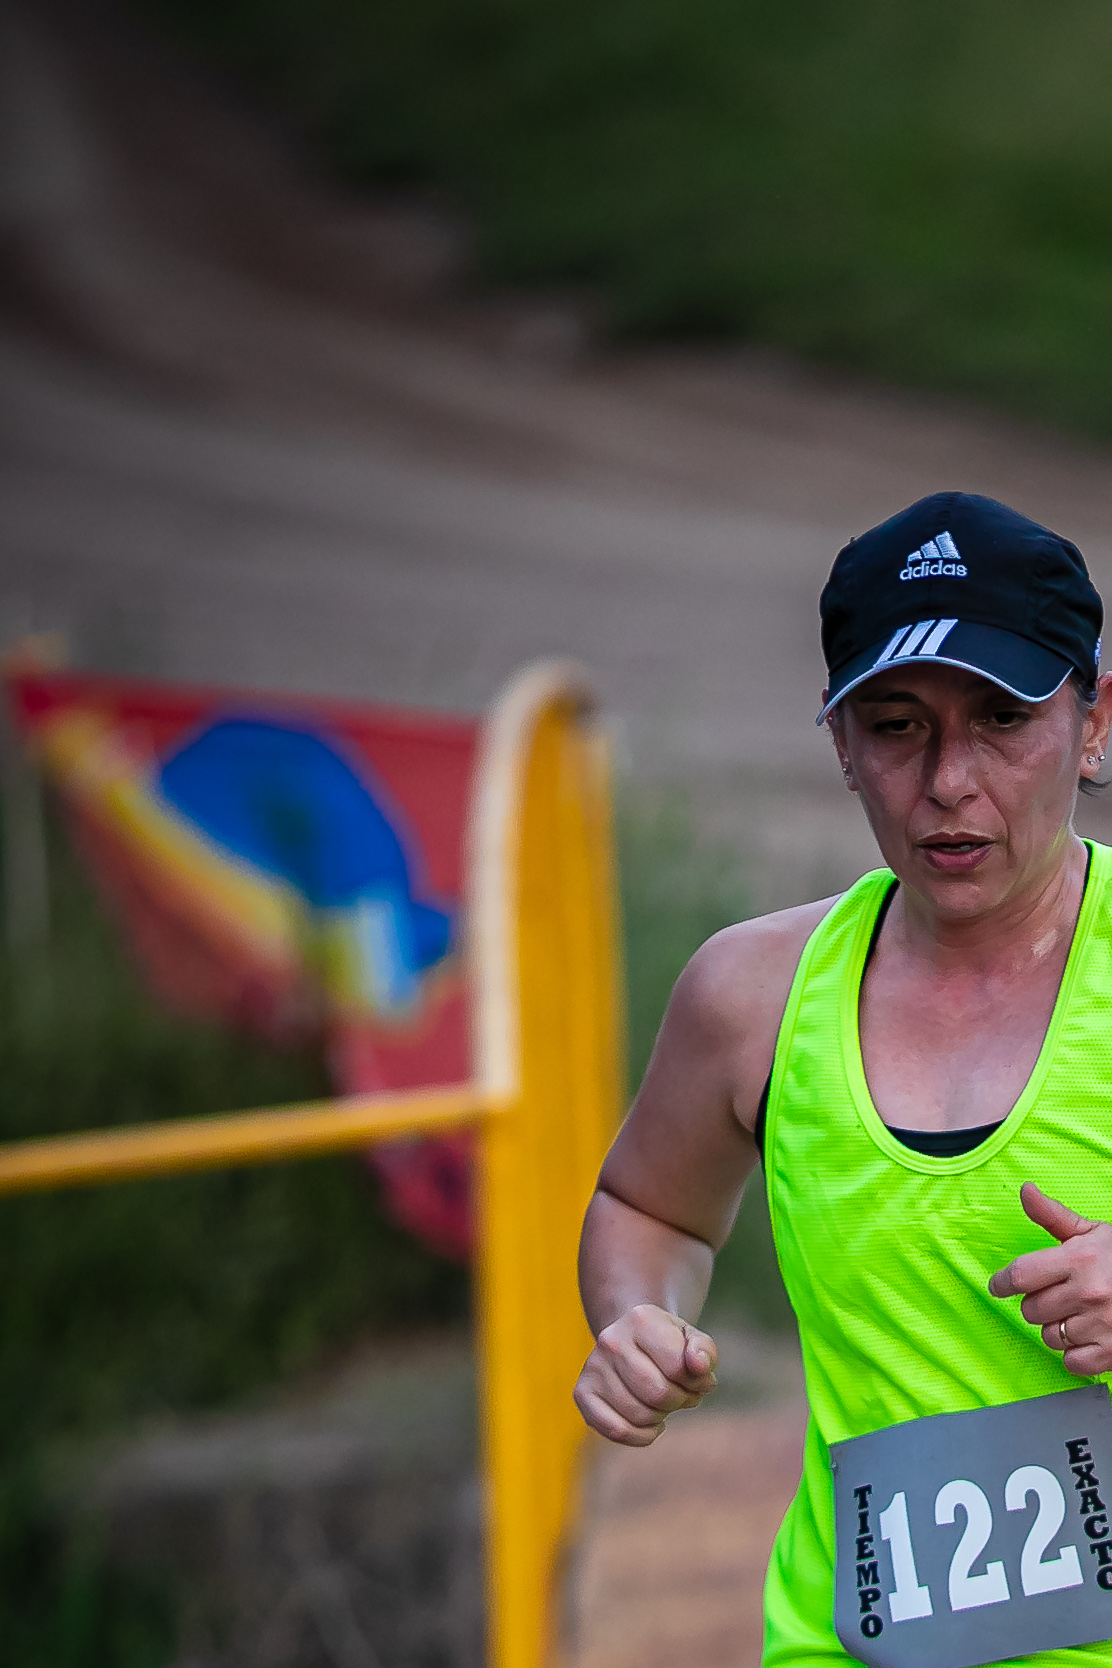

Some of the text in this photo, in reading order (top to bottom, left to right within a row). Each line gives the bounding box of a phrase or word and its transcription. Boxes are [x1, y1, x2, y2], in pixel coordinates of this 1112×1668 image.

[899, 559, 968, 580] adidas
[853, 1484, 884, 1639] TIEMPO
[879, 1464, 1084, 1624] 122
